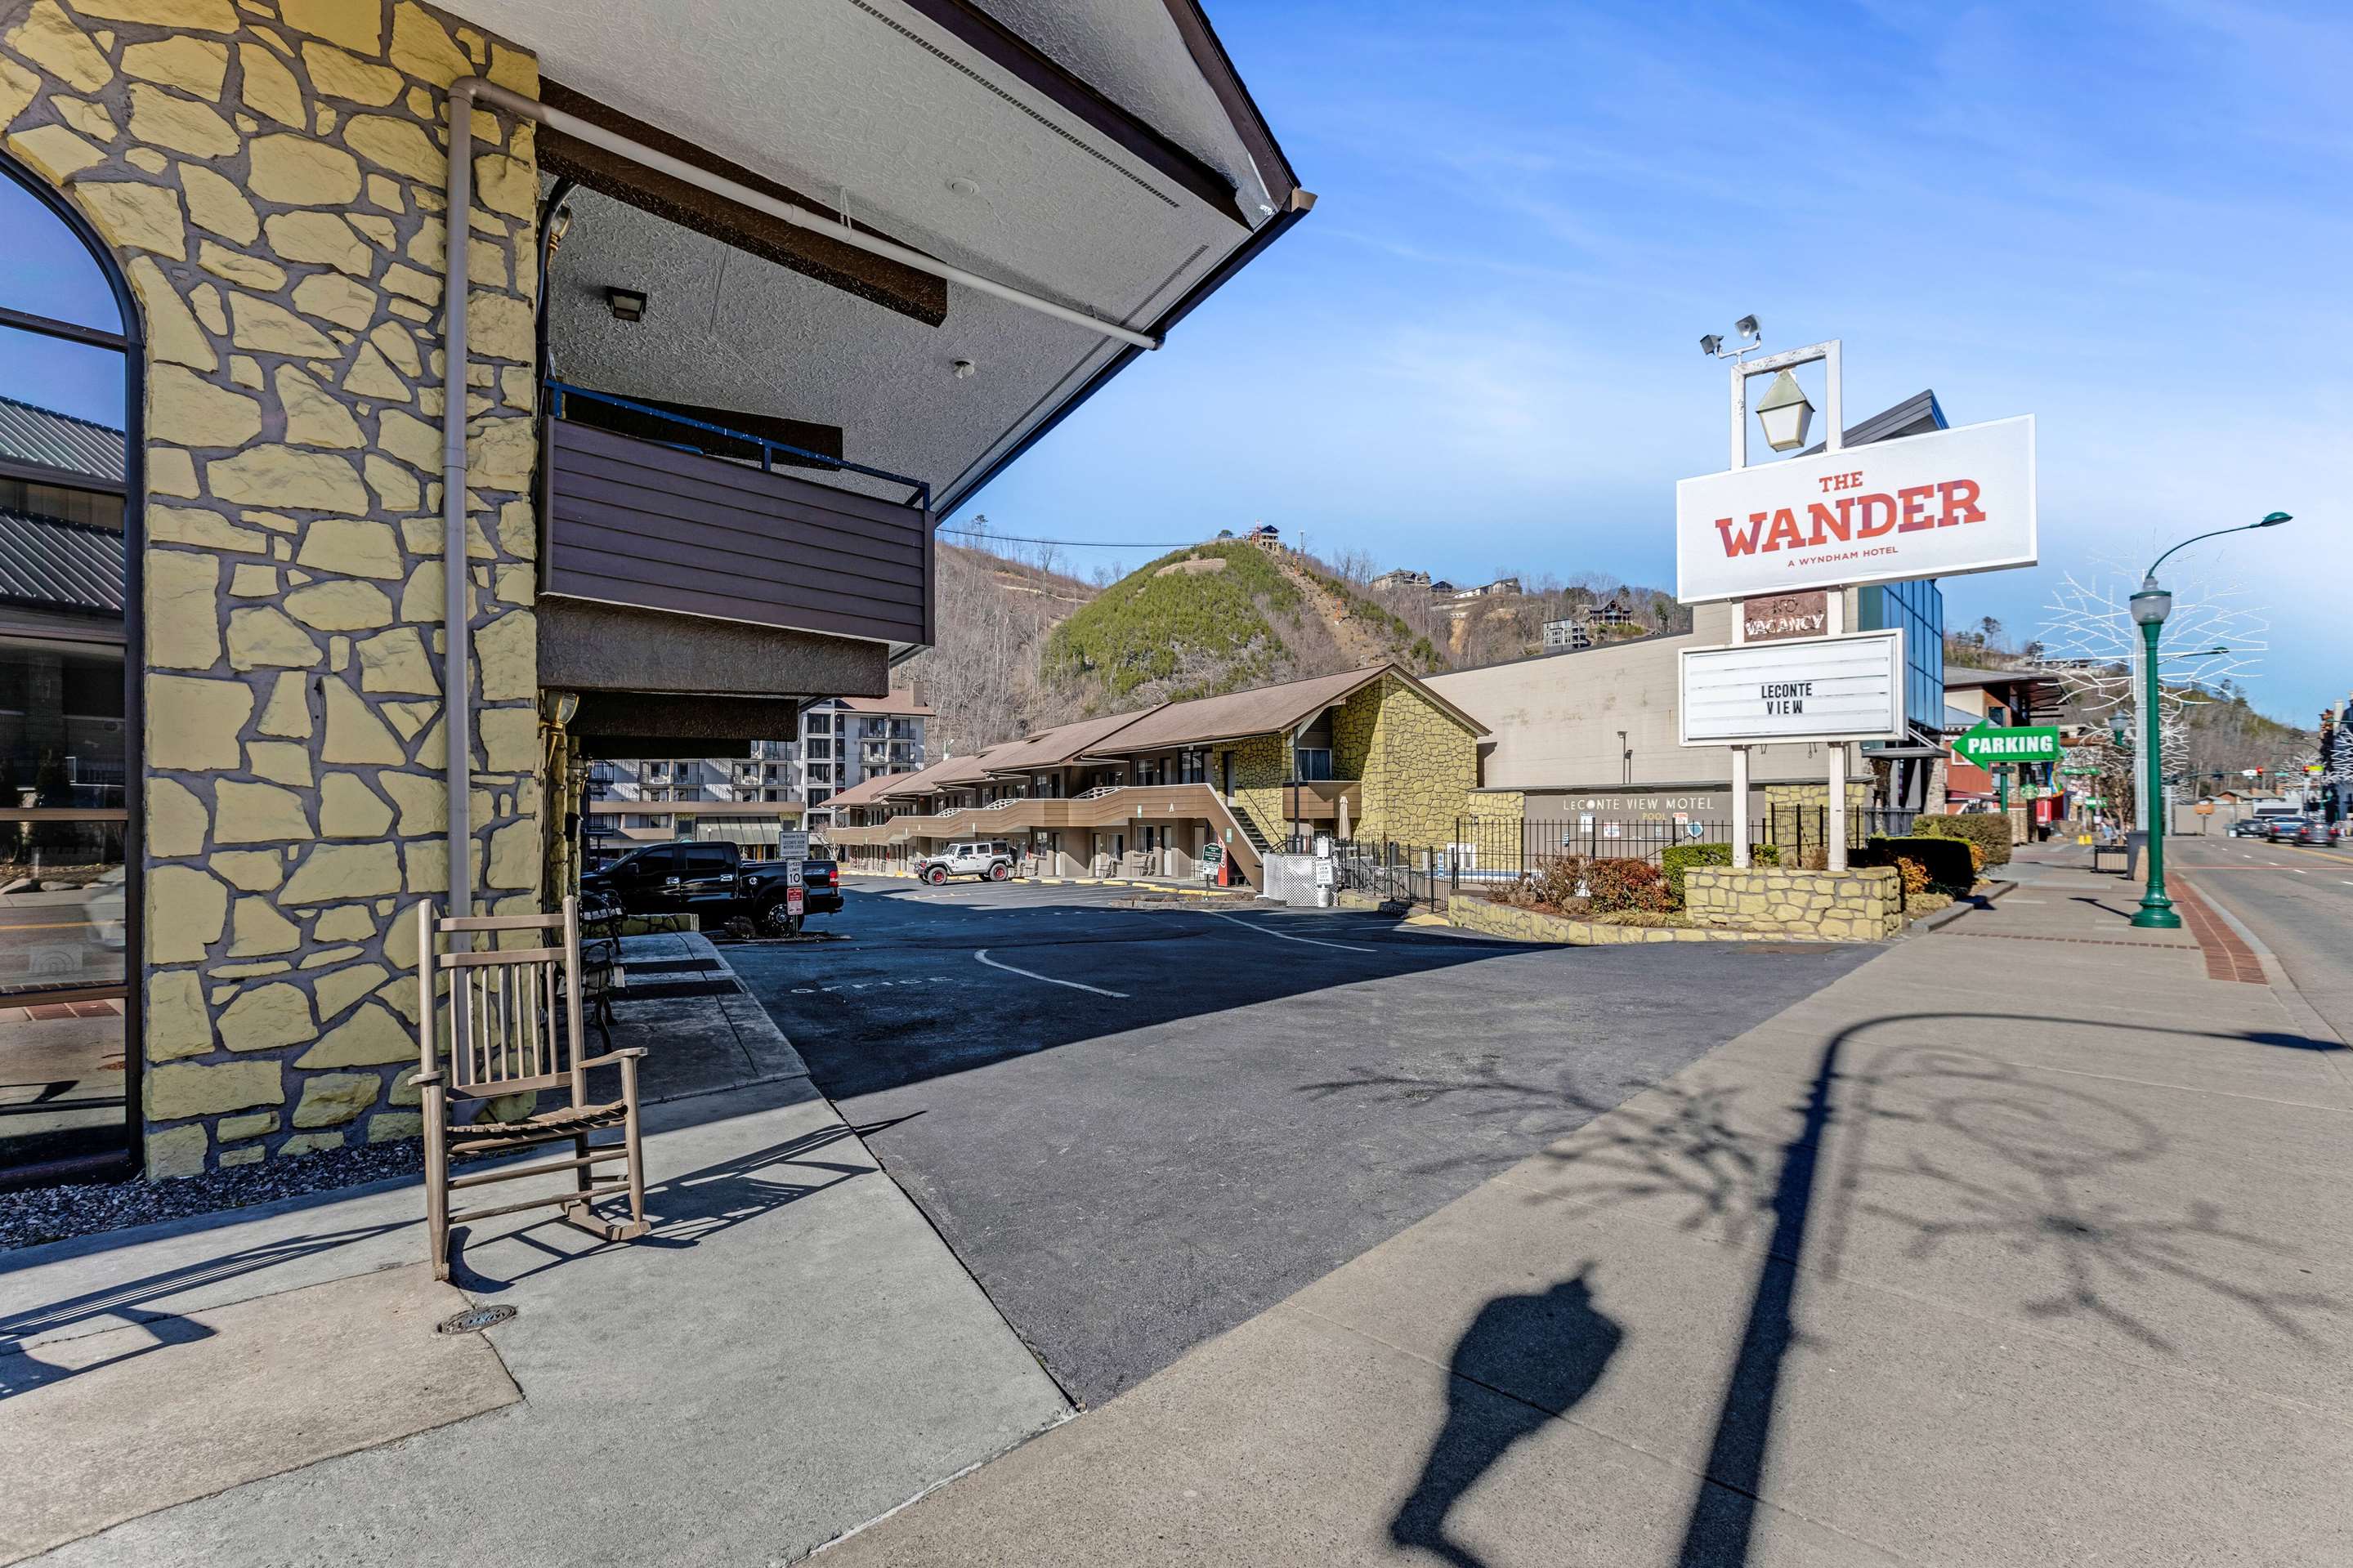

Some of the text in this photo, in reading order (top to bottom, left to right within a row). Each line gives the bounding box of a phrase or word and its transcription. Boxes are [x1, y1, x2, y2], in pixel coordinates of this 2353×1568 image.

[1818, 471, 1863, 493] THE
[1715, 478, 1986, 558] WANDER
[1787, 546, 1899, 568] A WYNDHAM HOTEL
[1745, 614, 1824, 636] VACANCY
[1761, 682, 1813, 699] LECONTE
[1767, 699, 1803, 715] VIEW
[1967, 735, 2054, 754] PARKING
[1626, 797, 1658, 810] VIEW
[1666, 797, 1715, 810] MOTEL
[1642, 812, 1667, 820] POOL
[790, 873, 801, 883] 10
